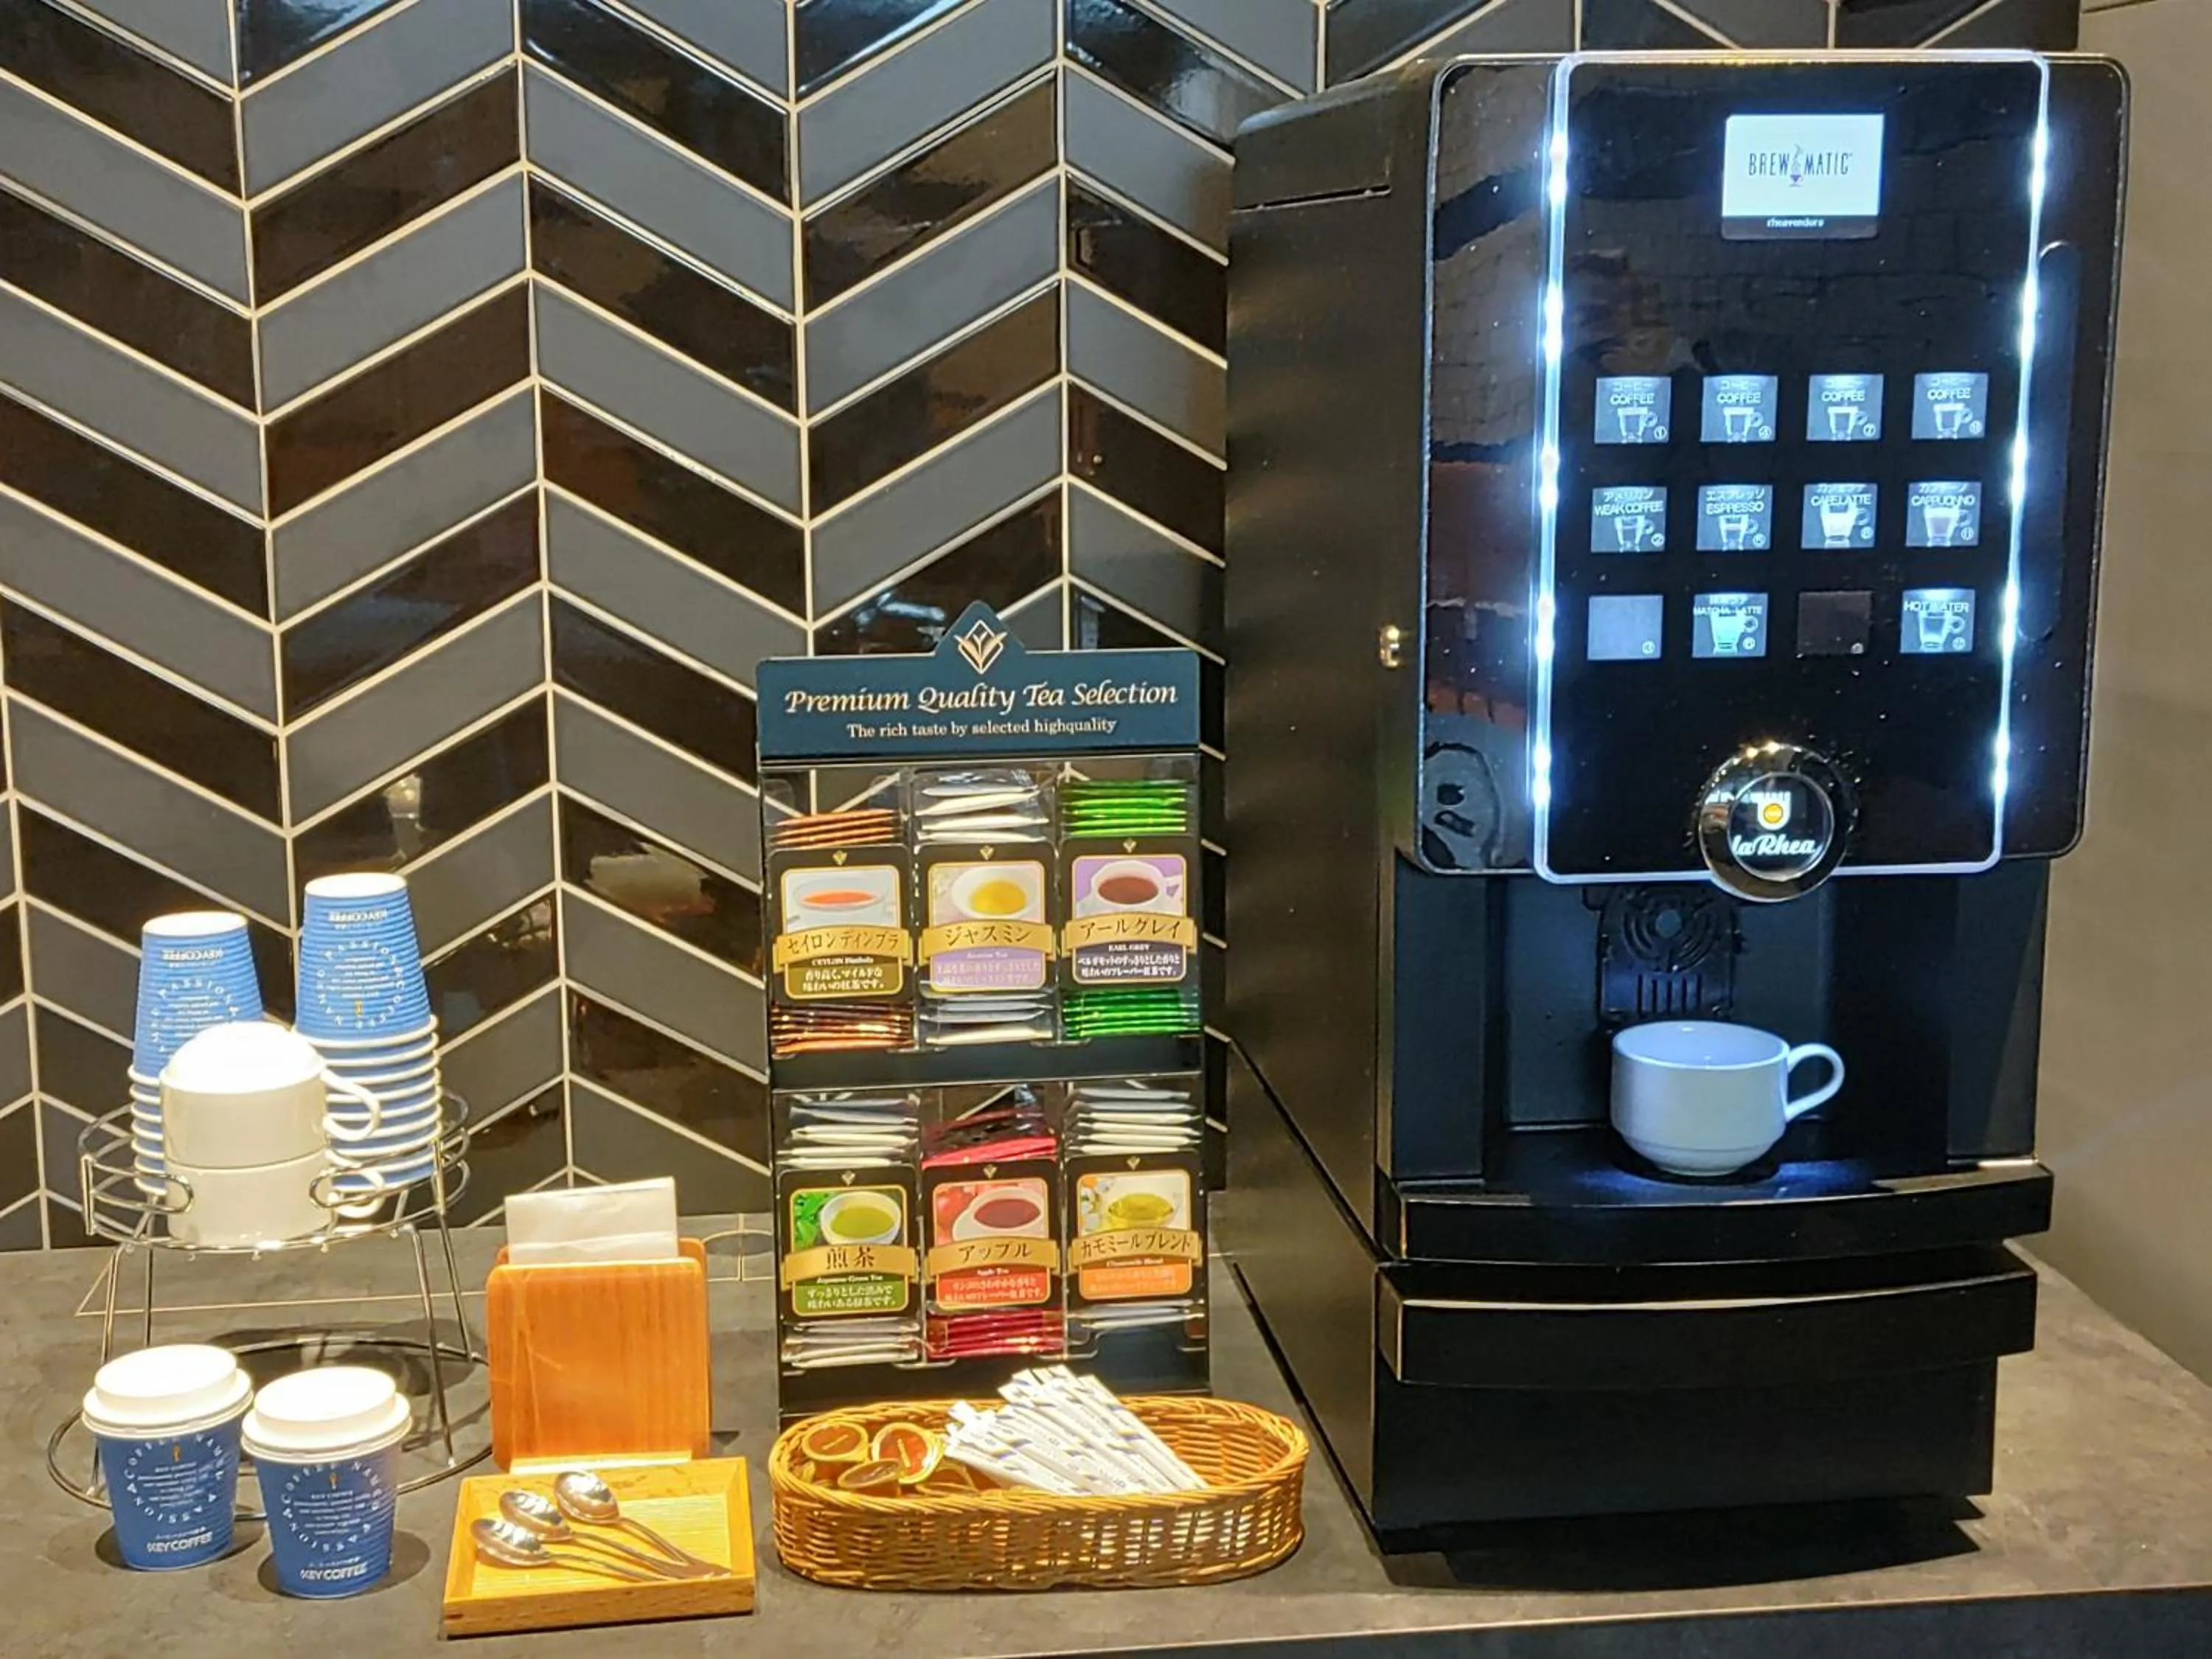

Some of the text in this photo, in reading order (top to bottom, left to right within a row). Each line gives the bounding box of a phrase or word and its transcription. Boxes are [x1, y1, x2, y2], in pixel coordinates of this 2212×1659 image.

[1717, 392, 1761, 403] COFFEE
[1822, 390, 1865, 402] COFFEE
[1927, 388, 1971, 400] COFFEE
[785, 679, 1178, 716] Premium Quality Tea Selection
[846, 717, 1118, 738] The rich taste by selected highquality
[945, 925, 1032, 947] ジャスミン
[1079, 918, 1180, 940] アールグレイ
[959, 1242, 1032, 1264] アップル
[1081, 1232, 1192, 1257] カモミールブレンド
[827, 1247, 875, 1270] 煎茶
